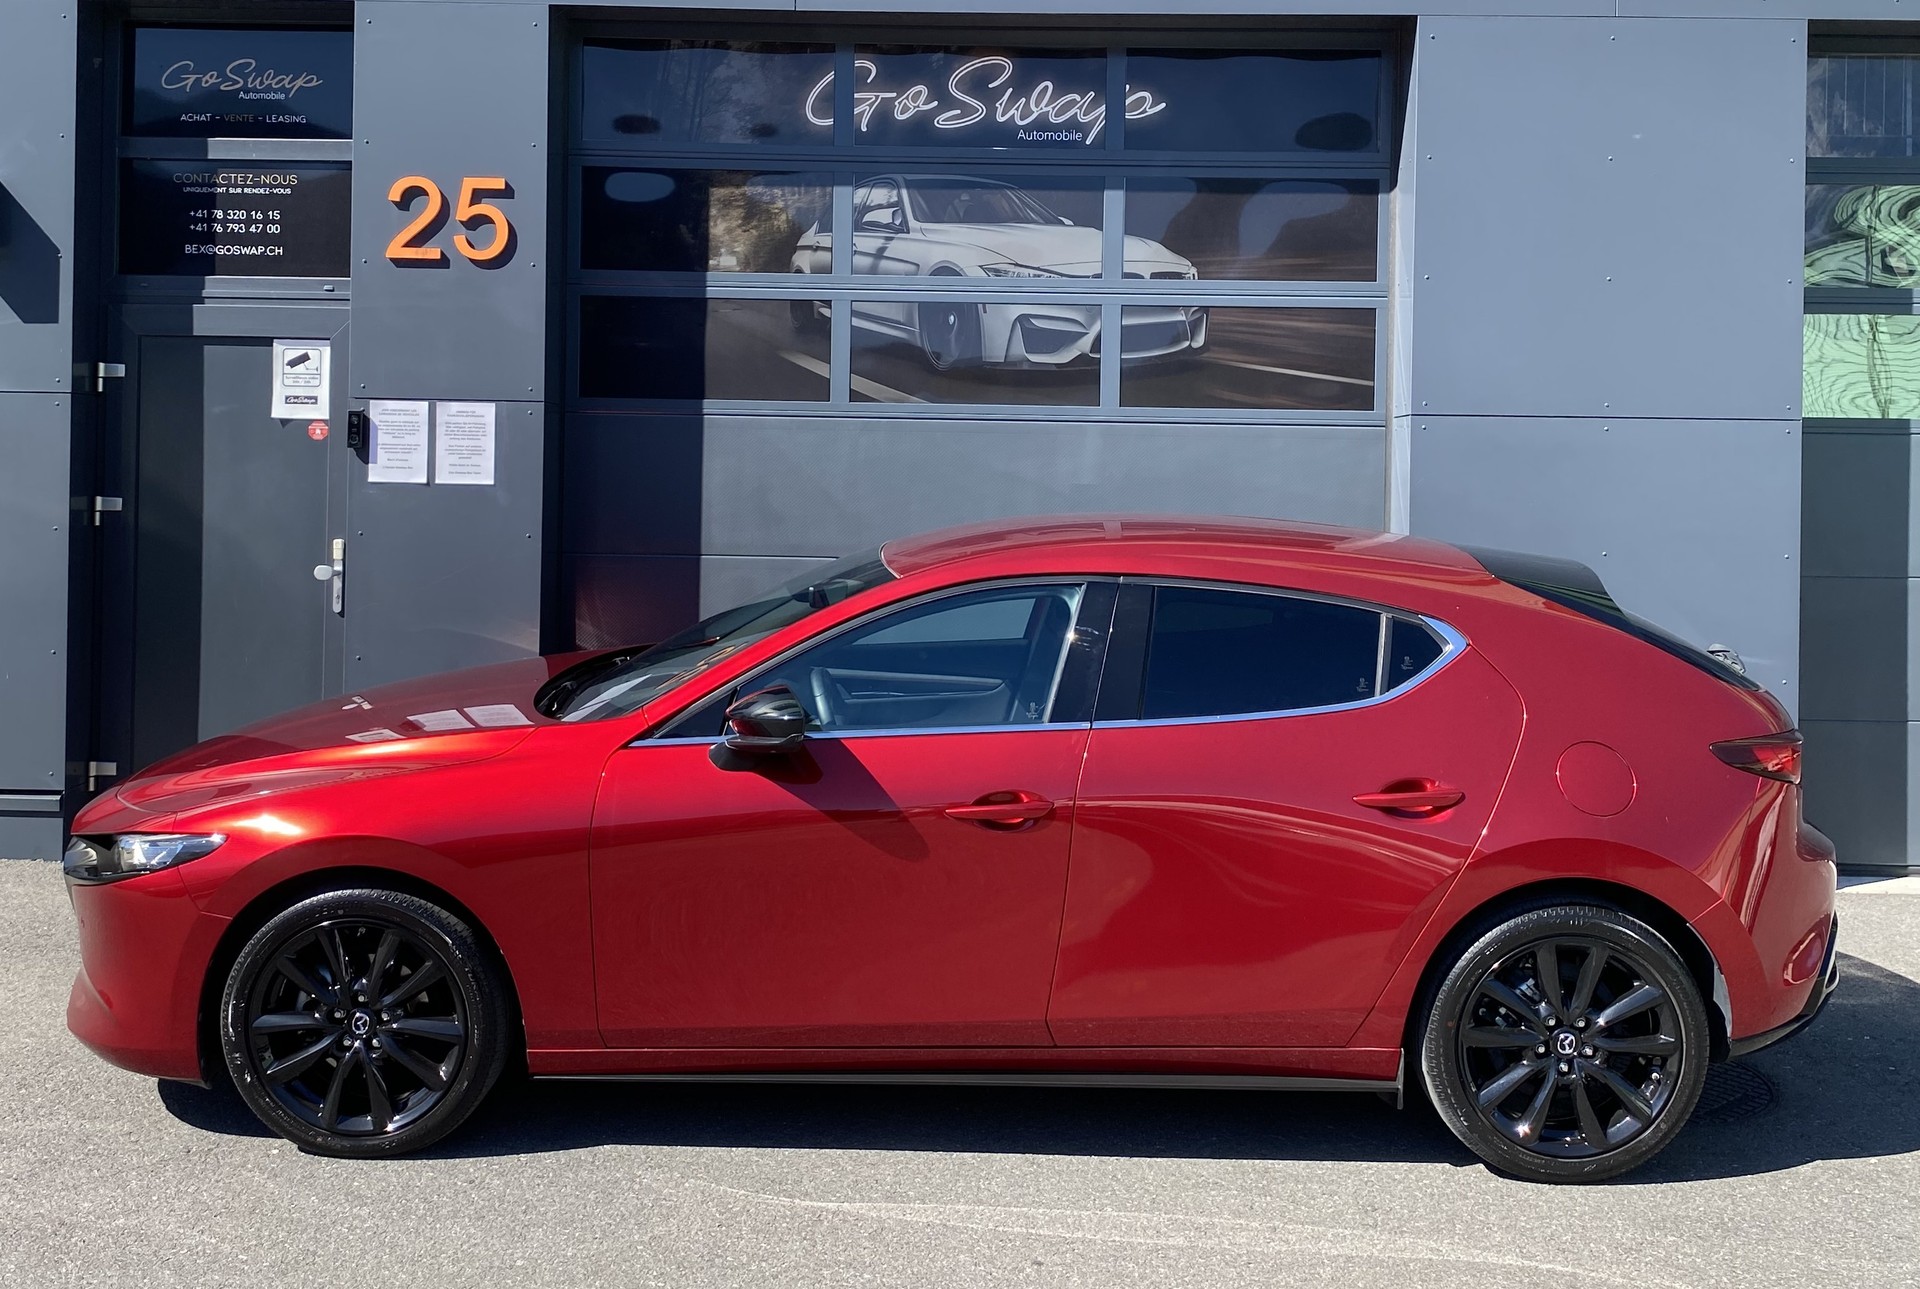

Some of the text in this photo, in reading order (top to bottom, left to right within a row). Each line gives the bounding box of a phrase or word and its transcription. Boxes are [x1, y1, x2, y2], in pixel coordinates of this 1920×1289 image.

[238, 91, 286, 100] Automobile
[180, 113, 212, 122] ACHAT
[224, 114, 254, 123] VENTE
[266, 114, 307, 123] LEASING
[1017, 129, 1083, 142] Automobile
[173, 173, 298, 185] CONTACTEZ-NOUS
[243, 187, 292, 195] RENDEZ-VOUS
[189, 209, 281, 220] +41 78 320 16 15
[385, 175, 509, 260] 25
[189, 223, 281, 233] +41 76 793 47 00
[184, 244, 283, 256] BEX@GOSWAP.CH
